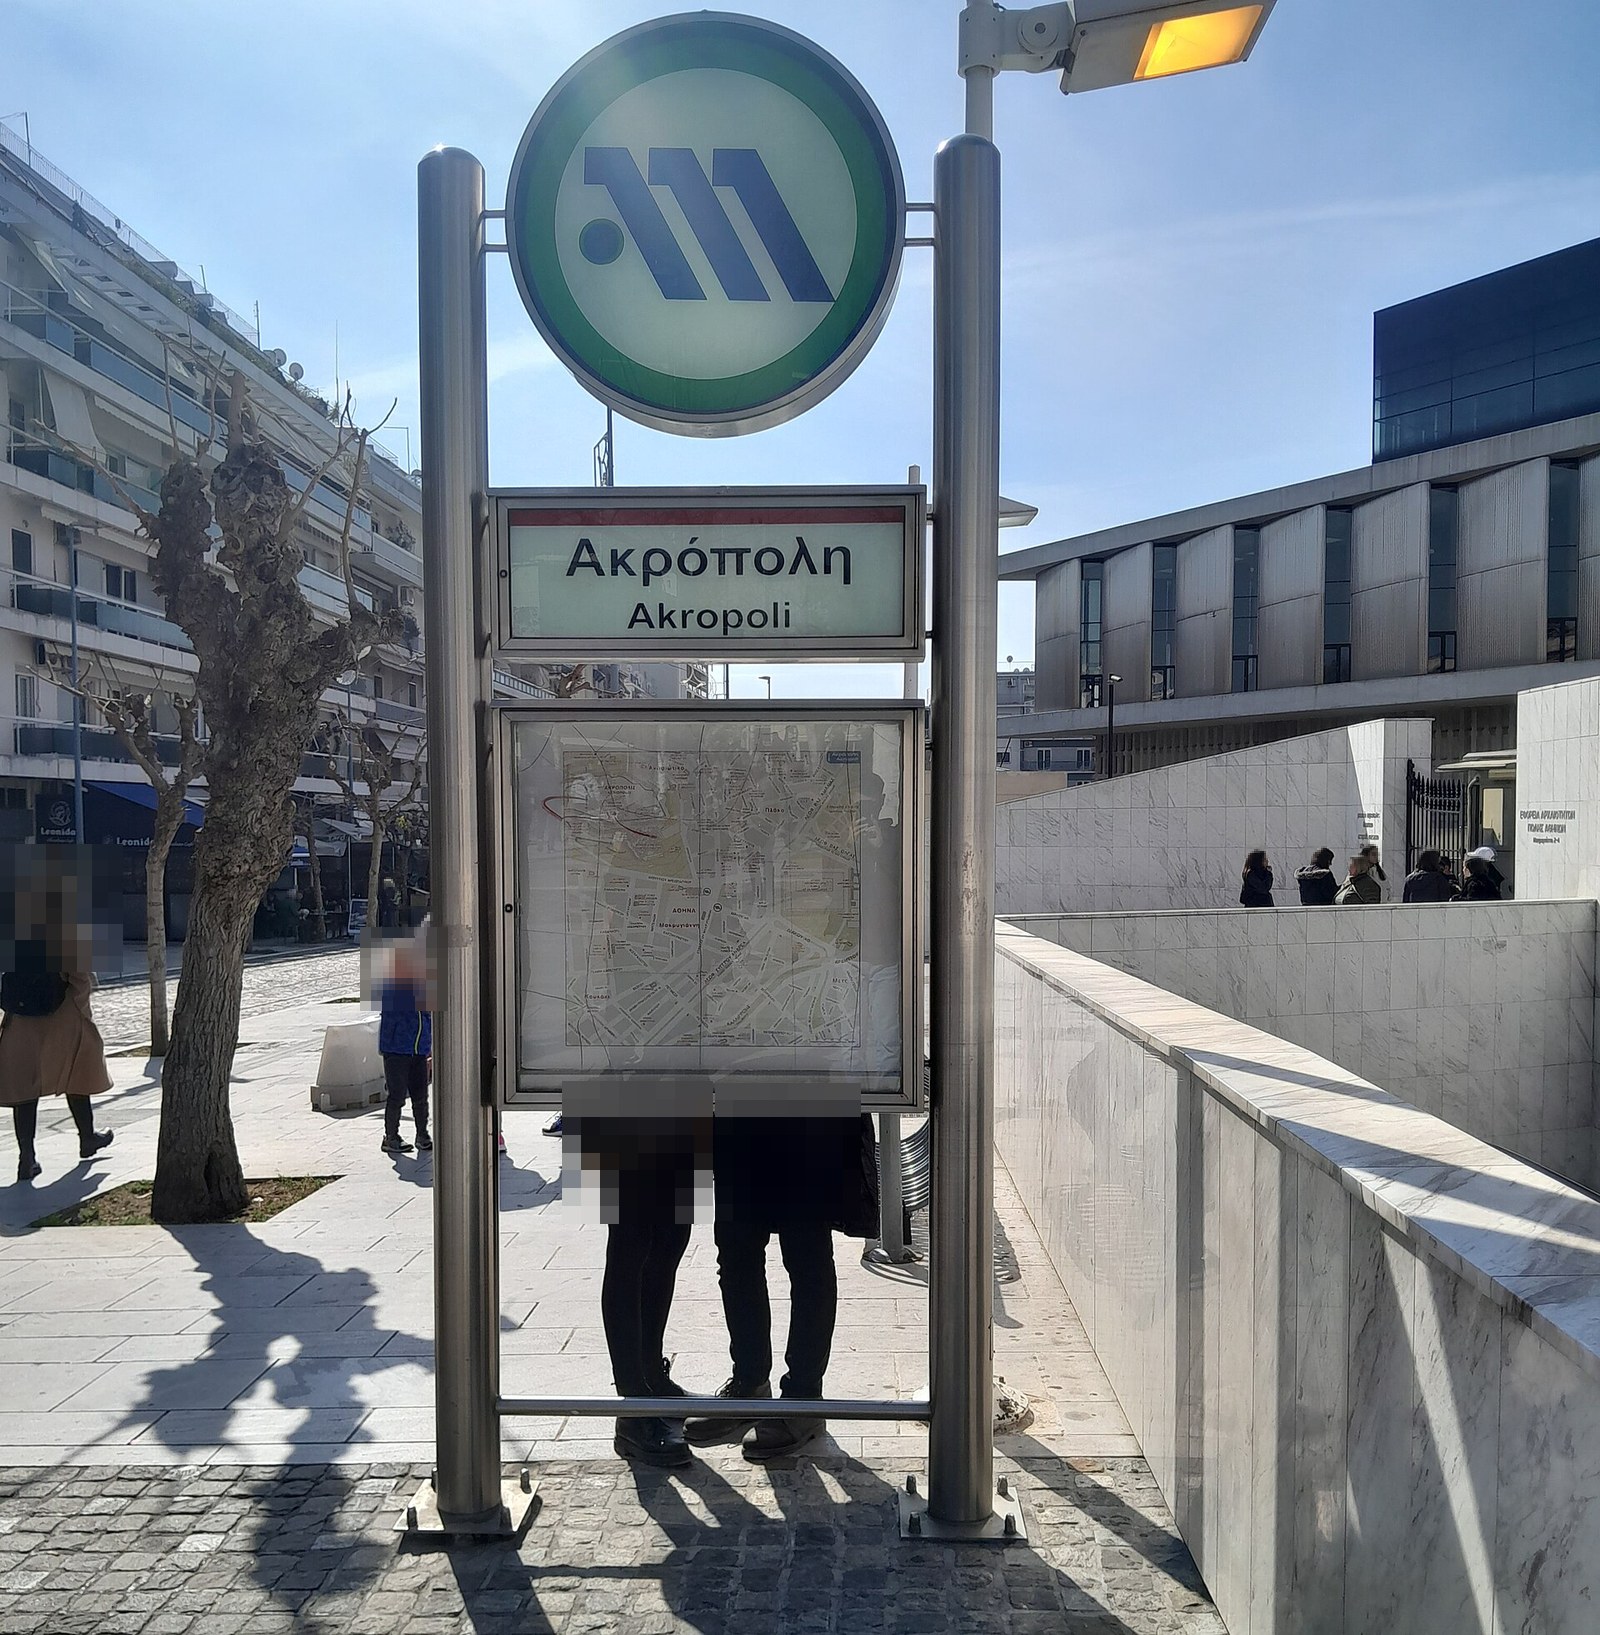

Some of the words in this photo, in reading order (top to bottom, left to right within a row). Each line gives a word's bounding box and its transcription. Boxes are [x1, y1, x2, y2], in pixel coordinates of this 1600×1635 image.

[566, 537, 851, 586] Ακρόπολη
[627, 602, 790, 635] Akropoli
[40, 826, 76, 836] Leonida
